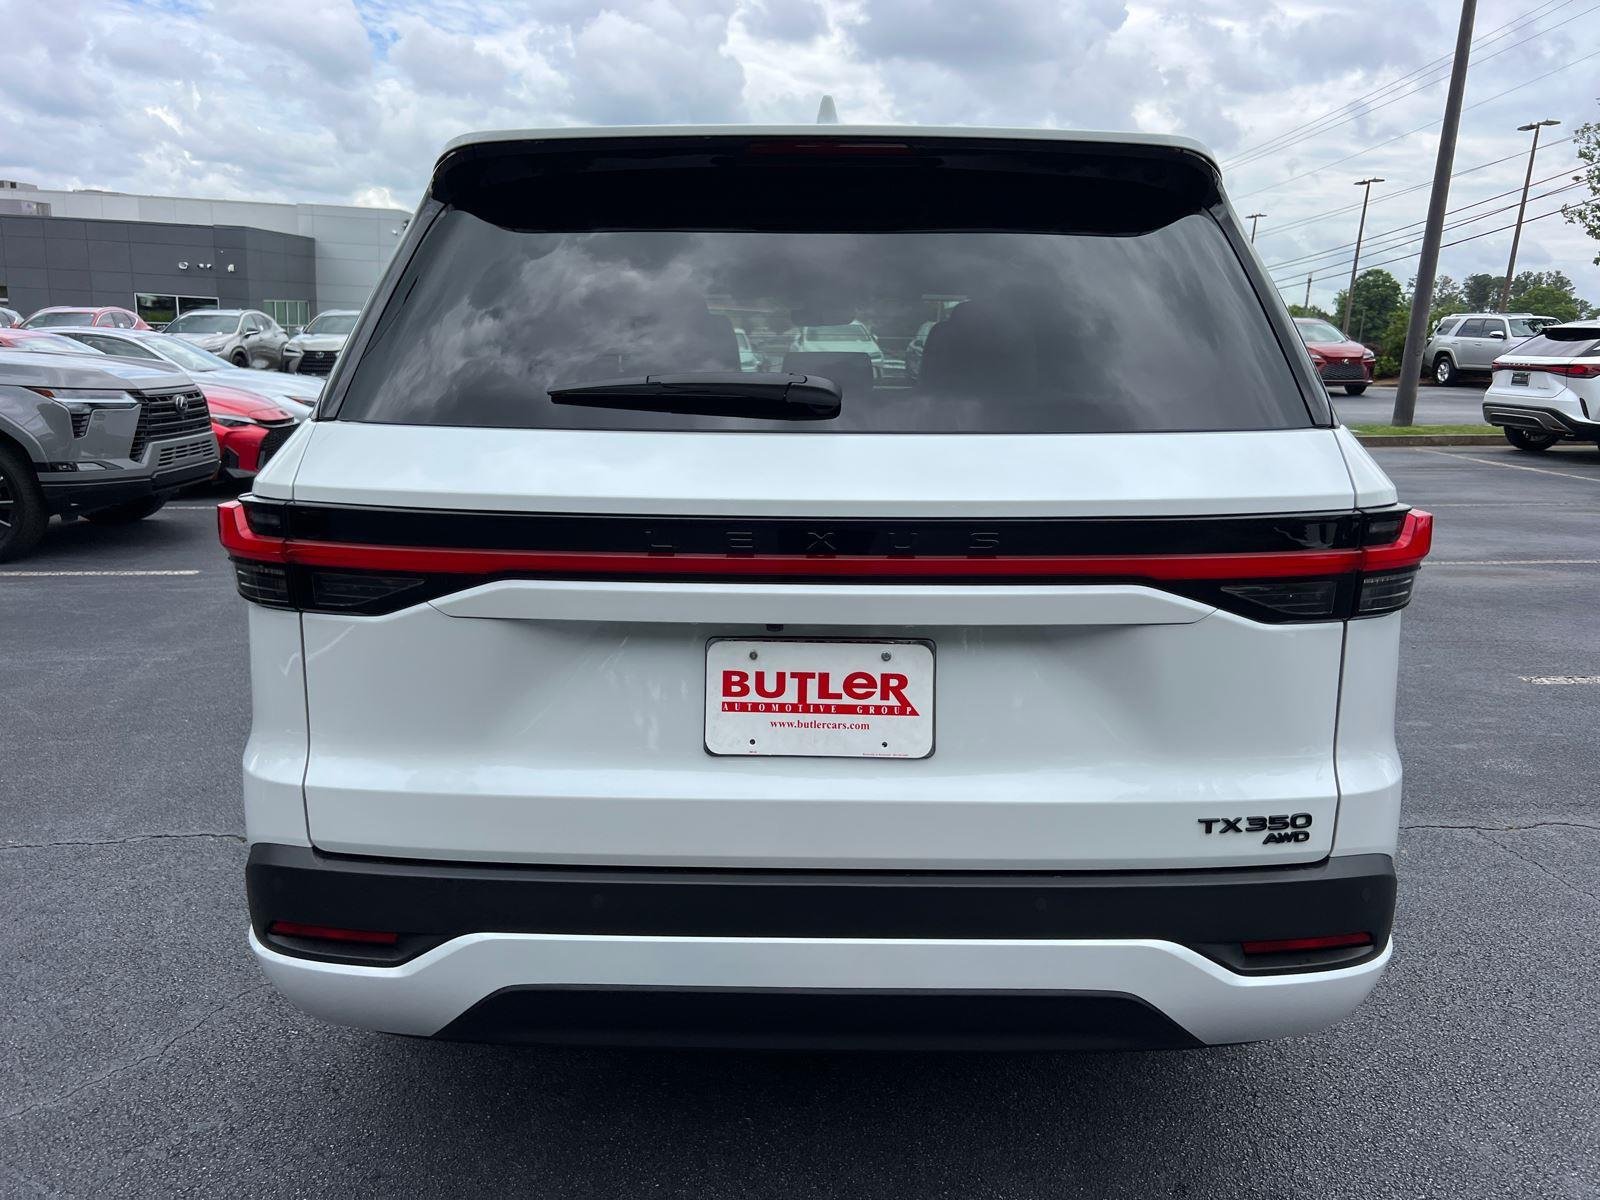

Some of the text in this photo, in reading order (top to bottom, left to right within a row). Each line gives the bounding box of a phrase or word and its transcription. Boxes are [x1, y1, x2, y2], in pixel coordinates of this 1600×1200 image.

[722, 702, 913, 716] AUTOMOTIVE GROUP
[769, 719, 870, 731] www.butlercars.com
[1262, 830, 1310, 845] AWD
